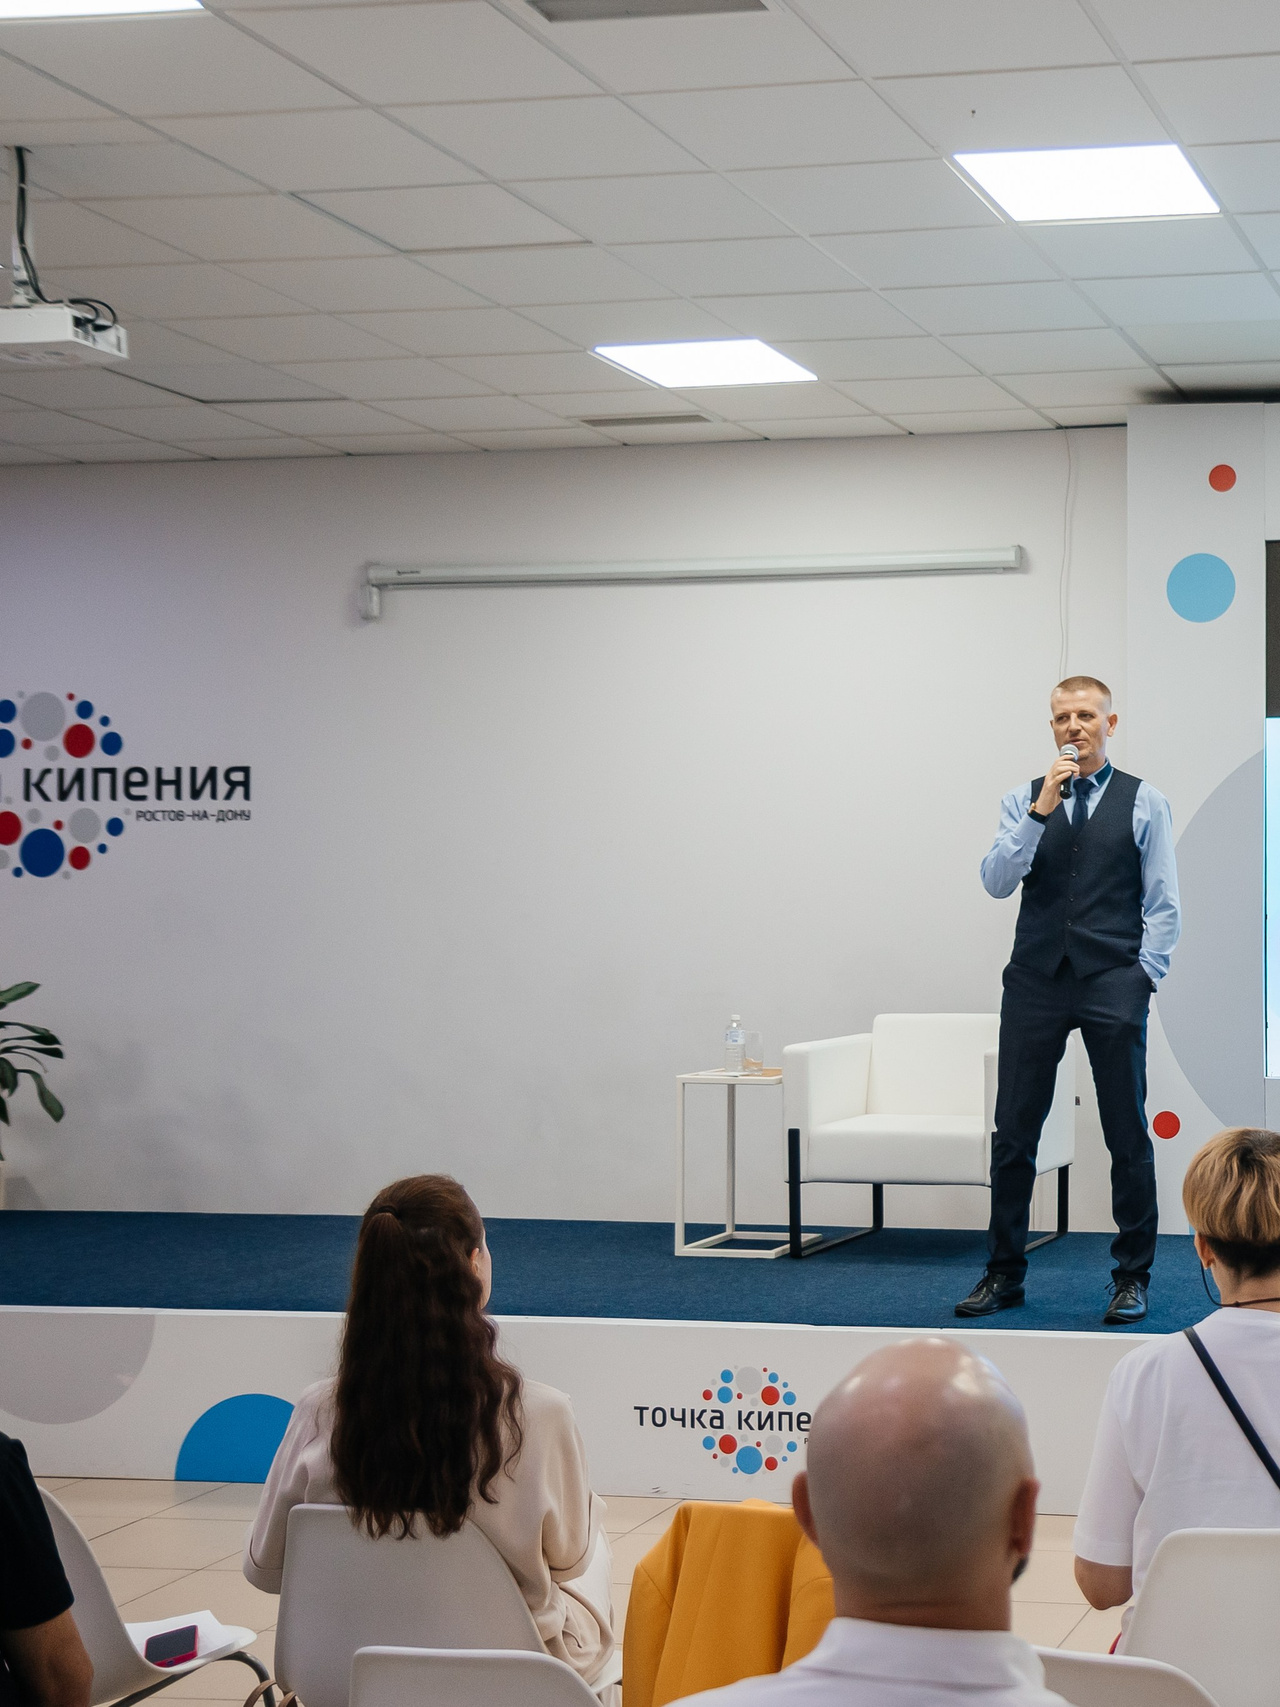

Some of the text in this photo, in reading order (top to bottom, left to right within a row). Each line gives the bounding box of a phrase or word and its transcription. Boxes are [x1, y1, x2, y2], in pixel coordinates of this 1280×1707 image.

[23, 766, 252, 803] кипения
[136, 809, 252, 823] РОСТОВ-НА-ДОНУ
[633, 1405, 812, 1432] точка кипе
